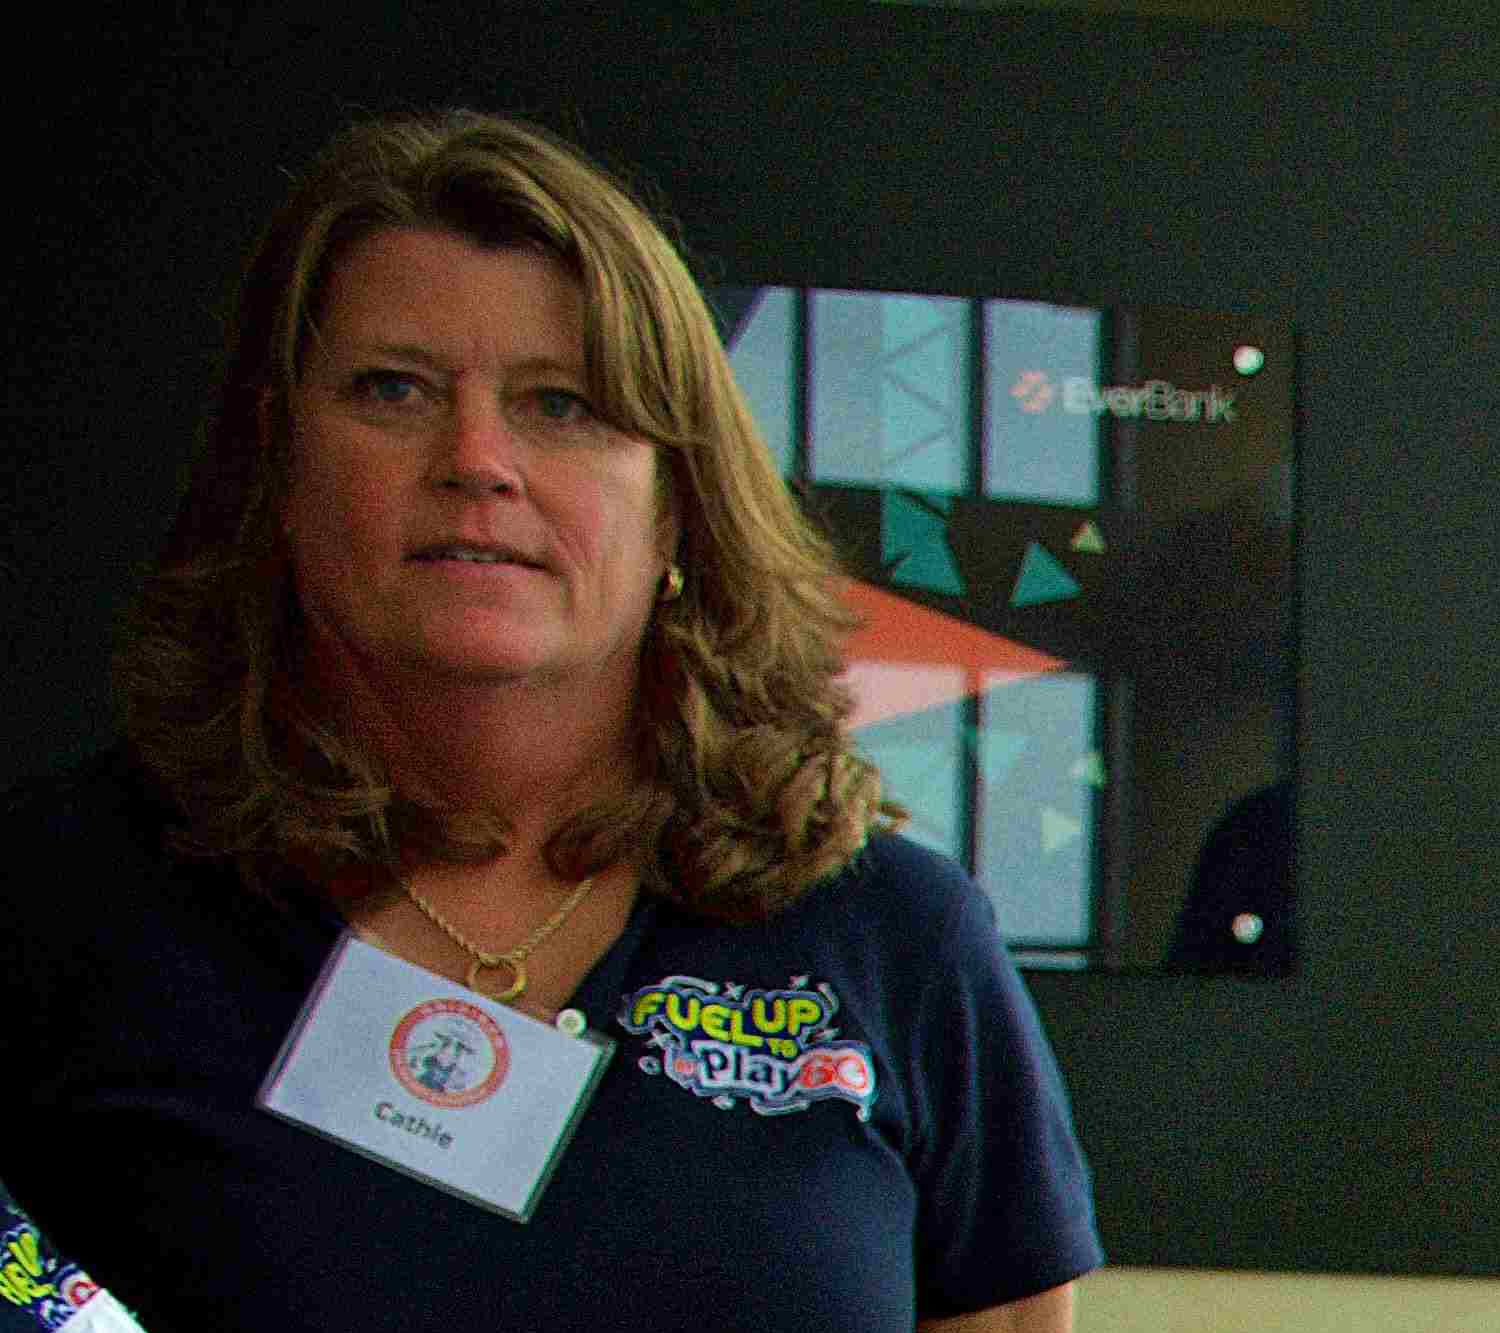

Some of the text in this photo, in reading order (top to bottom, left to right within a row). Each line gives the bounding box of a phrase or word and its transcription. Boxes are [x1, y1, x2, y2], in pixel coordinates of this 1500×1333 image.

[1063, 376, 1234, 424] EverBank
[633, 992, 821, 1047] FUEL UP
[374, 1101, 455, 1149] Cathie
